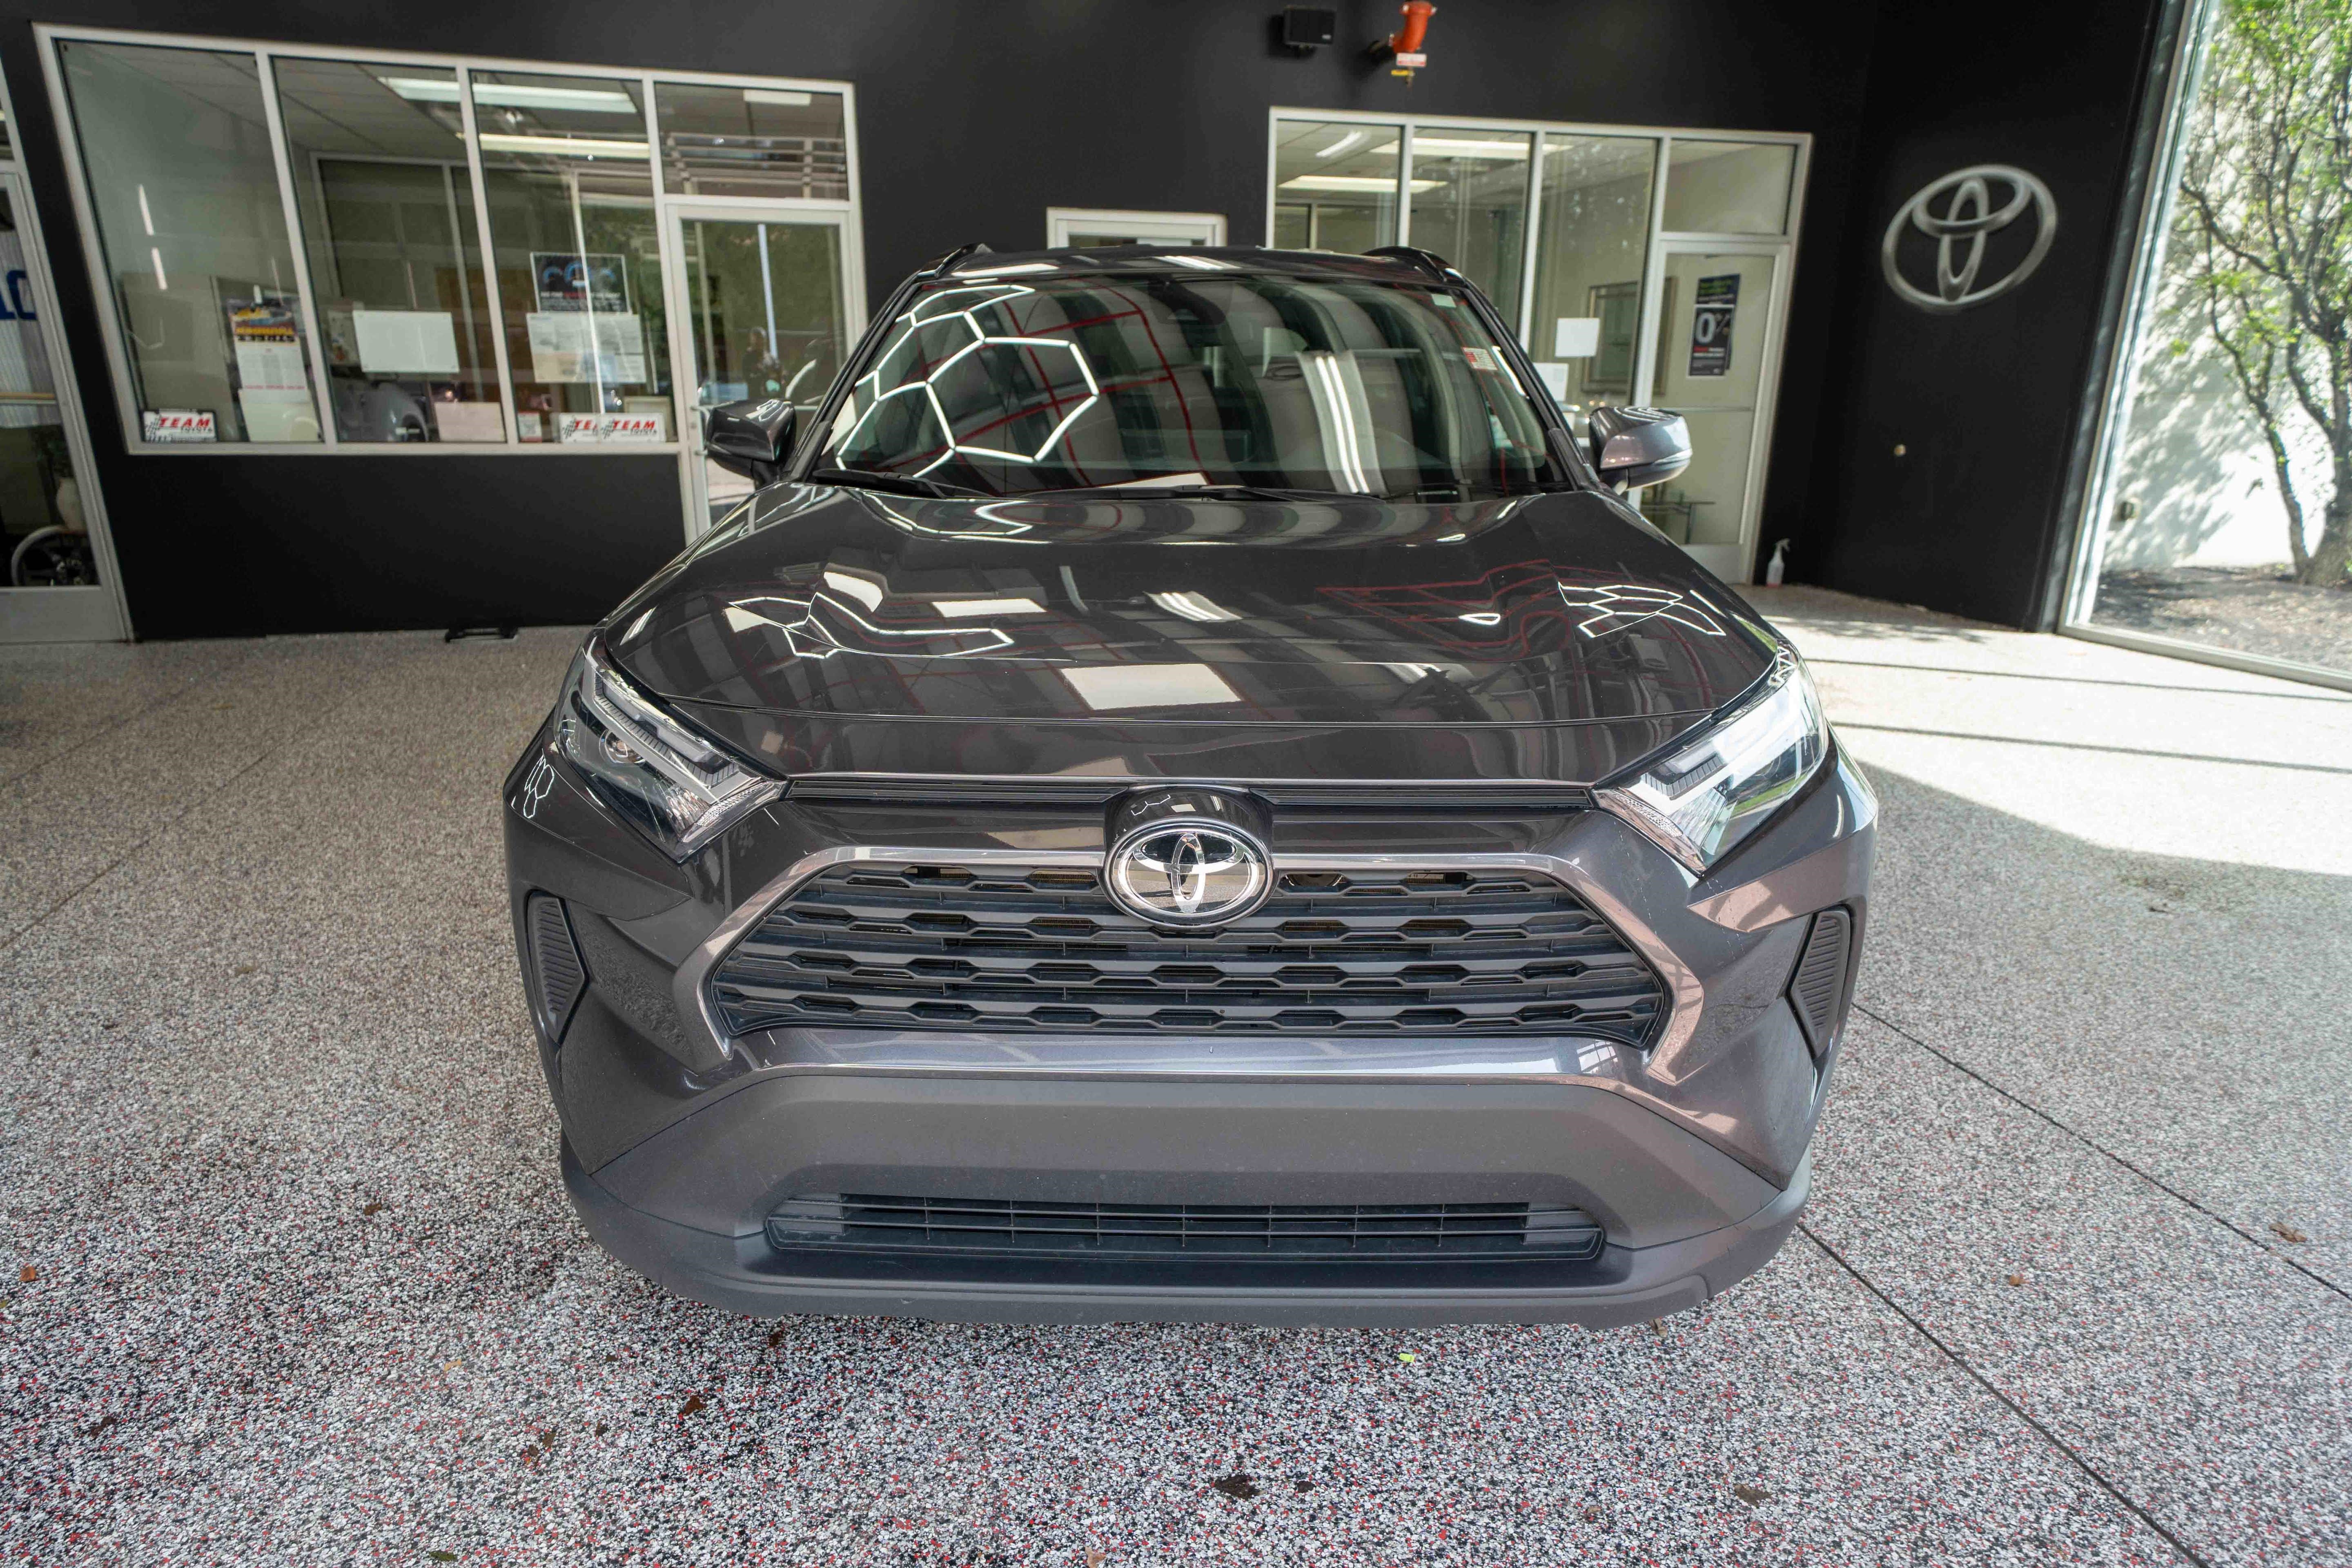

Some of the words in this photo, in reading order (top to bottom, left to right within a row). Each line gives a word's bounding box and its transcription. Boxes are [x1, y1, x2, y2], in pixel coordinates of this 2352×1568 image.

[1696, 312, 1730, 344] 0%
[159, 417, 210, 428] TEAM
[575, 420, 598, 430] TE
[612, 419, 655, 430] TEAM
